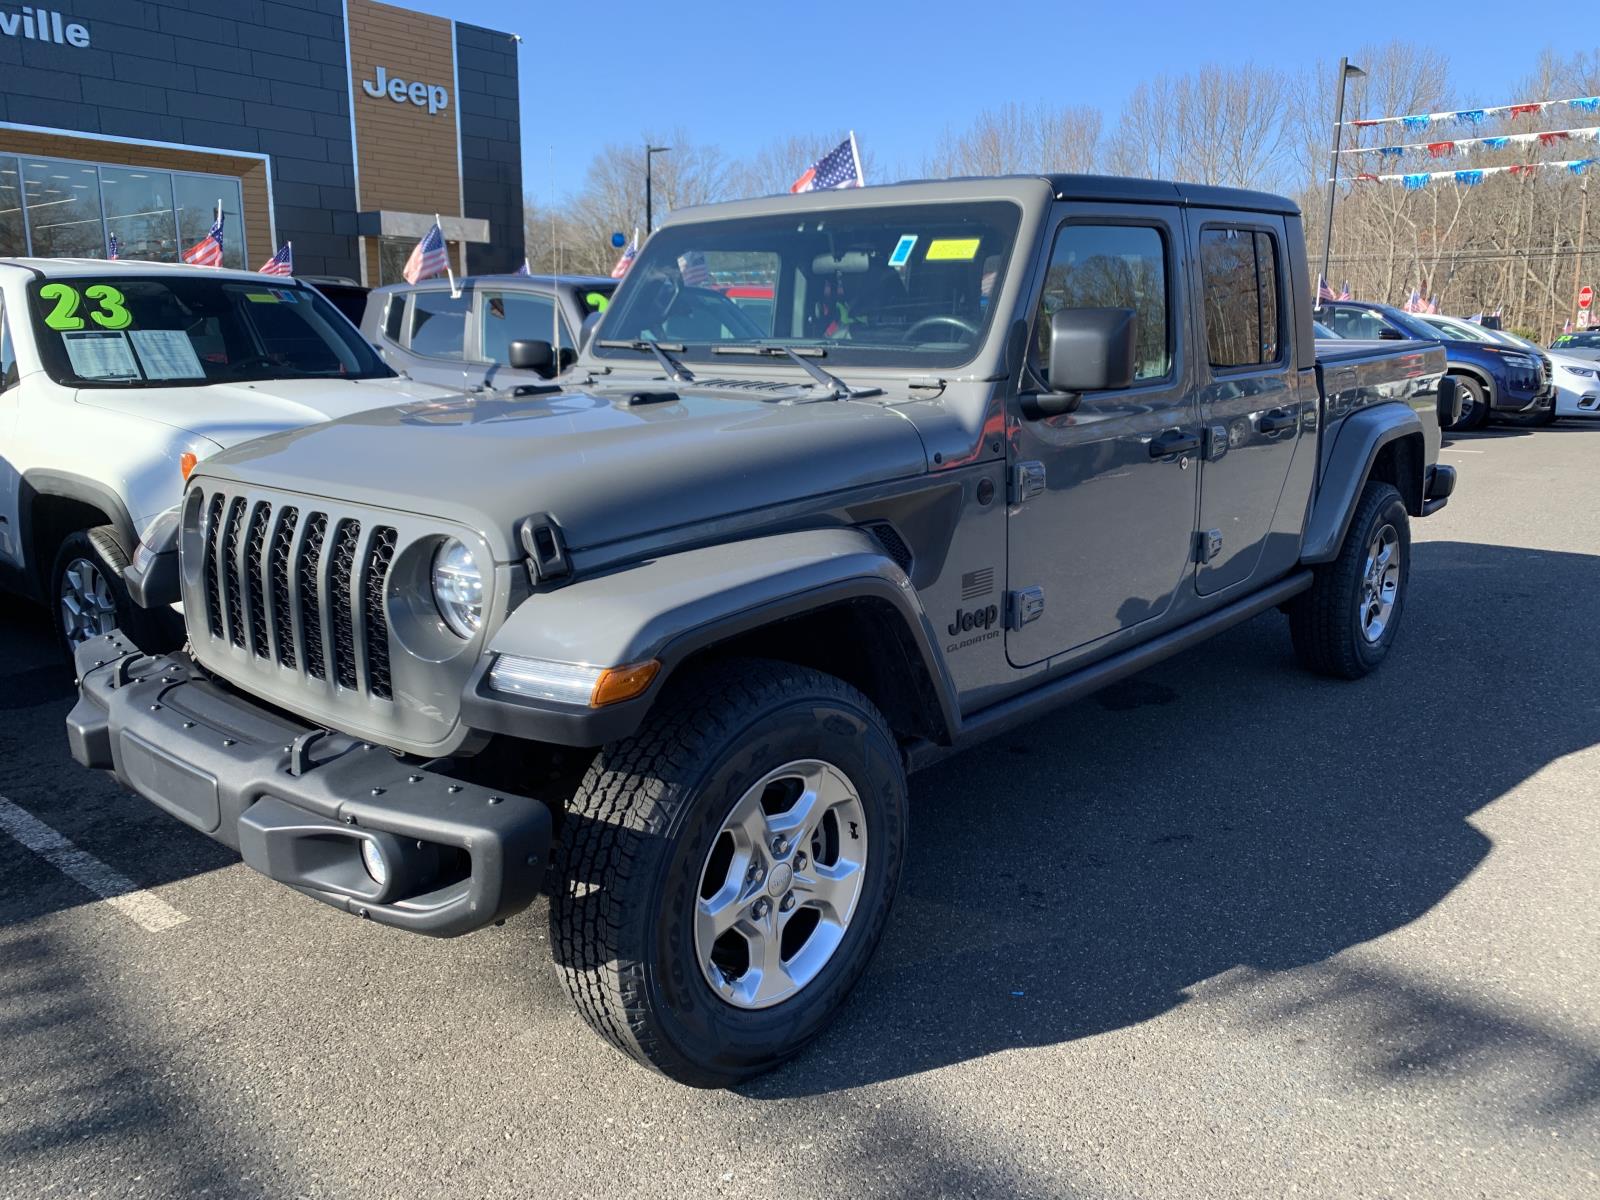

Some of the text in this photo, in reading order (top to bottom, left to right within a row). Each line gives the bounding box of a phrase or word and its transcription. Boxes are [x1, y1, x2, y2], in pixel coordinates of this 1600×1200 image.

[0, 6, 90, 48] ville
[362, 66, 448, 115] Jeep
[40, 283, 133, 331] 23
[948, 604, 998, 636] Jeep
[946, 630, 999, 653] GLADIATOR
